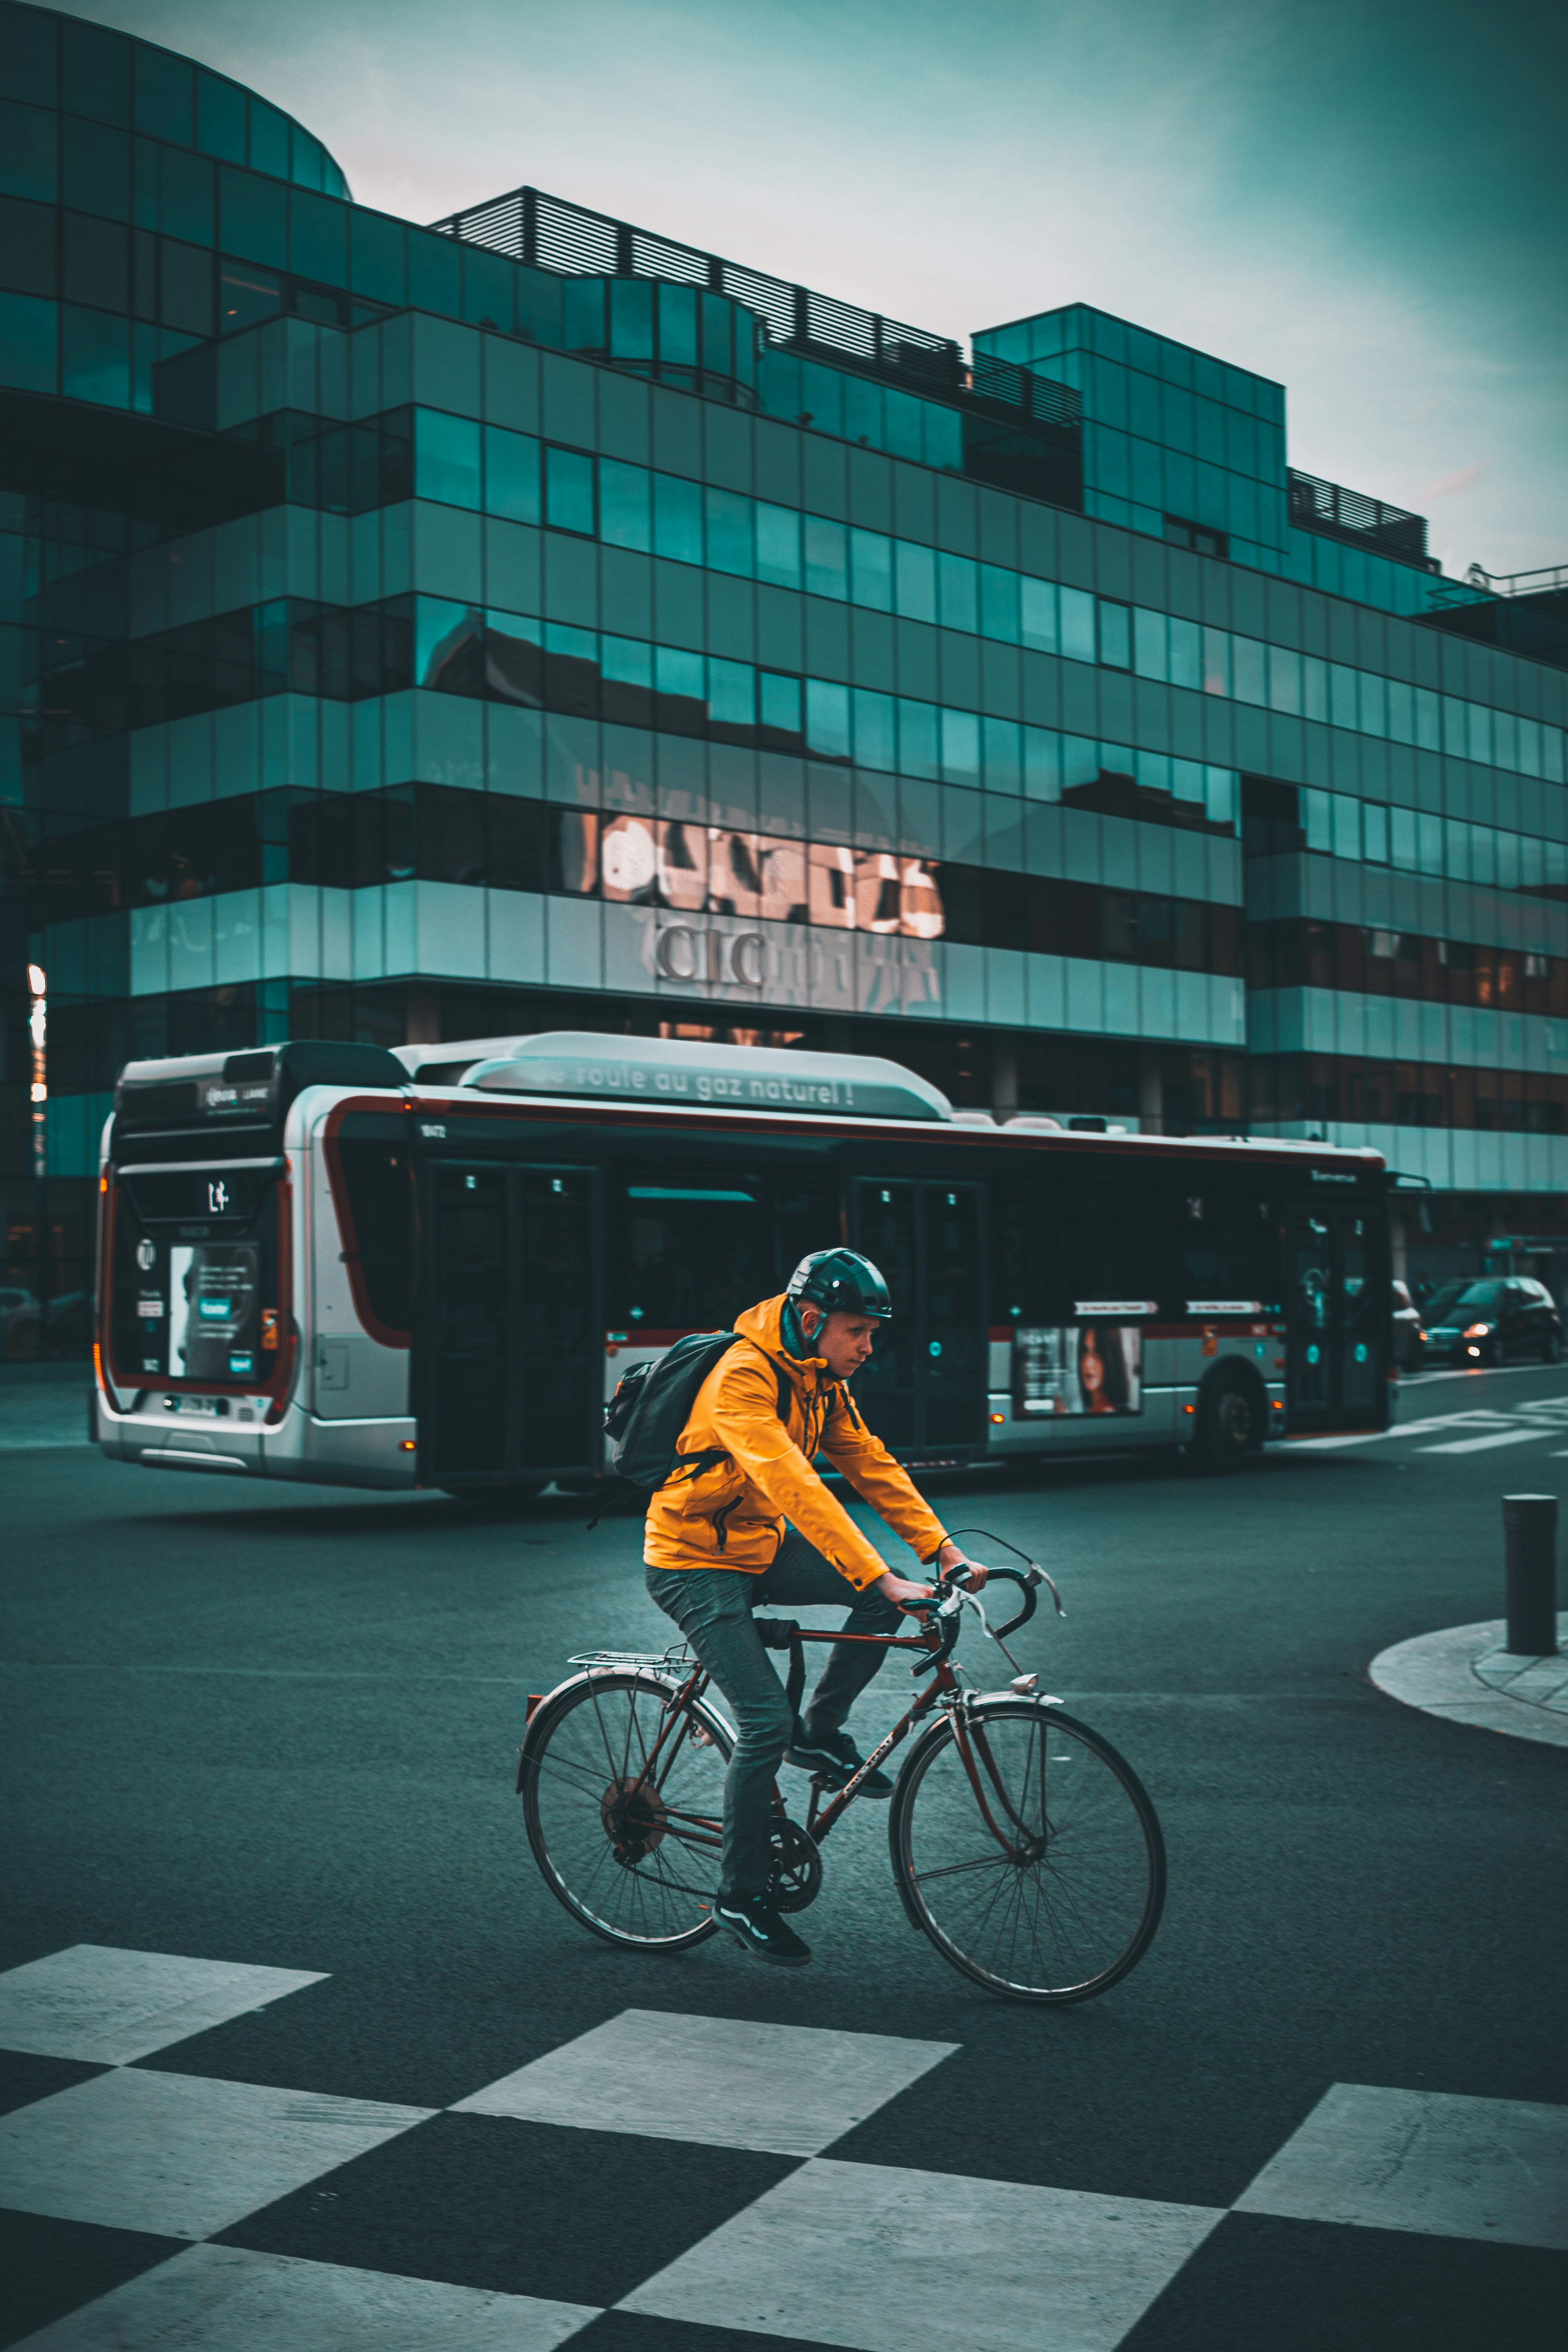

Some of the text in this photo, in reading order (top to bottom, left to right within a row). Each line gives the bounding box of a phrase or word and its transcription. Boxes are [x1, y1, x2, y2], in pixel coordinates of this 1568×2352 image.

[658, 925, 765, 987] CIC
[577, 1063, 646, 1089] roule
[655, 1072, 688, 1092] au
[696, 1076, 742, 1101] gaz
[750, 1078, 839, 1104] naturel
[846, 1080, 854, 1105] !
